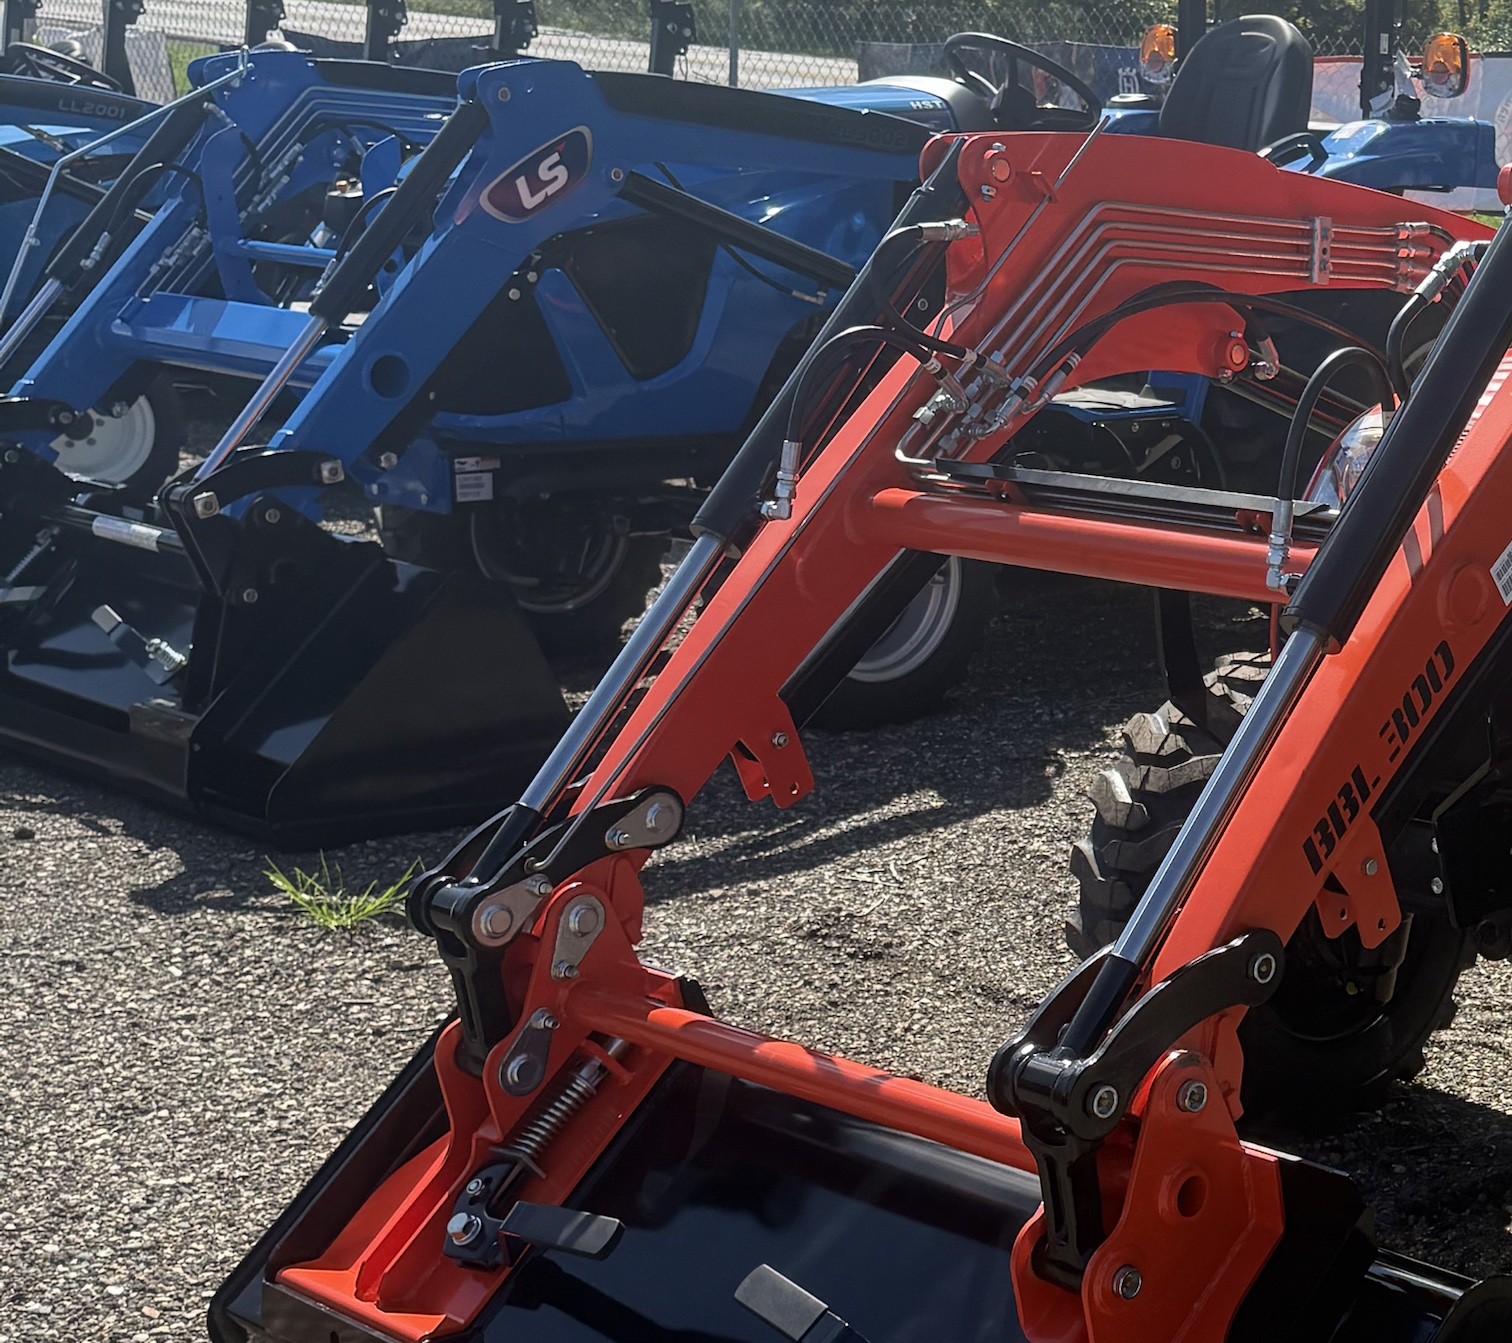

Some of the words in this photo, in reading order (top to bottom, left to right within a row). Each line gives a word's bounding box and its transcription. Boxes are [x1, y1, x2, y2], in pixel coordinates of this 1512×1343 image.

[58, 99, 126, 119] LL2001
[909, 100, 943, 110] HST
[515, 152, 569, 210] LS
[1302, 764, 1381, 876] BBL
[1379, 640, 1455, 763] 300
